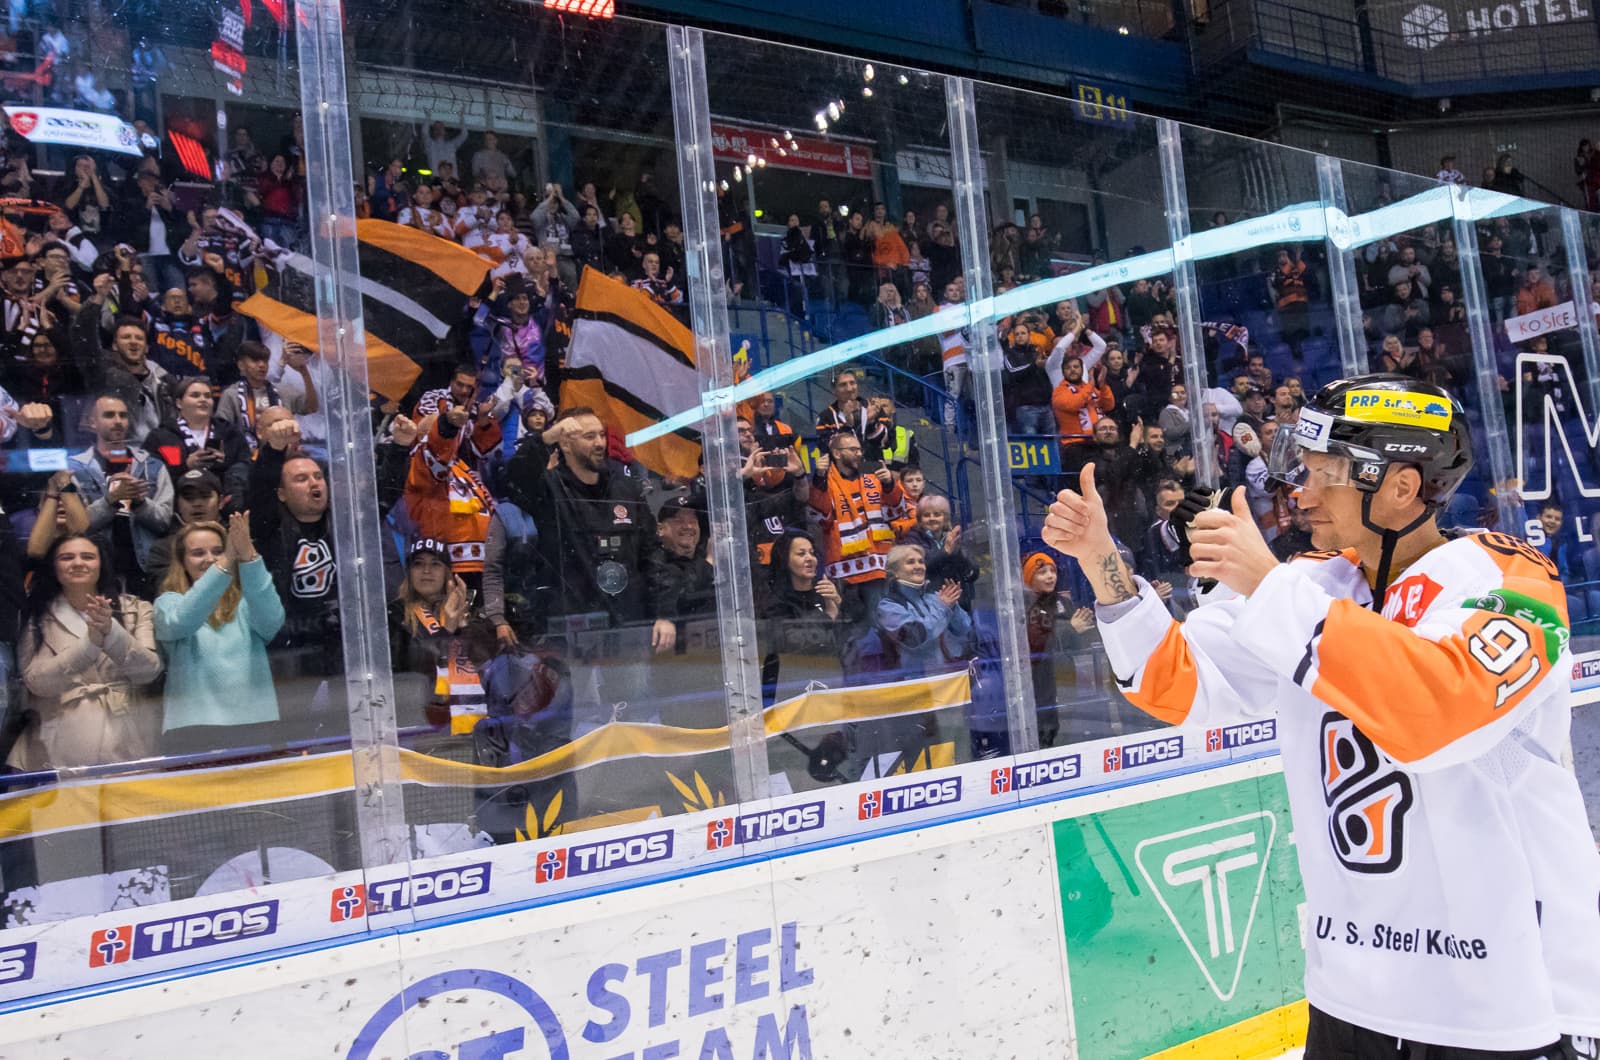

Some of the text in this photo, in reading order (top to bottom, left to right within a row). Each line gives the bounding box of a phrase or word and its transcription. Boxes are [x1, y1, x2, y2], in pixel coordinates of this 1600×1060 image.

[1466, 0, 1589, 37] HOTEL
[1350, 395, 1380, 407] PRP
[1010, 444, 1050, 467] B11
[1384, 443, 1428, 453] CCM
[410, 538, 444, 553] ICON
[1224, 721, 1274, 747] TIPOS
[1125, 738, 1182, 766] TIPOS
[1015, 756, 1079, 788] TIPOS
[886, 778, 959, 812] TIPOS
[740, 804, 820, 841] TIPOS
[574, 835, 668, 872] TIPOS
[375, 866, 485, 908] TIPOS
[143, 904, 271, 952] TIPOS
[1315, 915, 1336, 941] U.
[1345, 921, 1364, 946] S.
[1372, 923, 1420, 952] Steel
[581, 920, 814, 1044] STEEL
